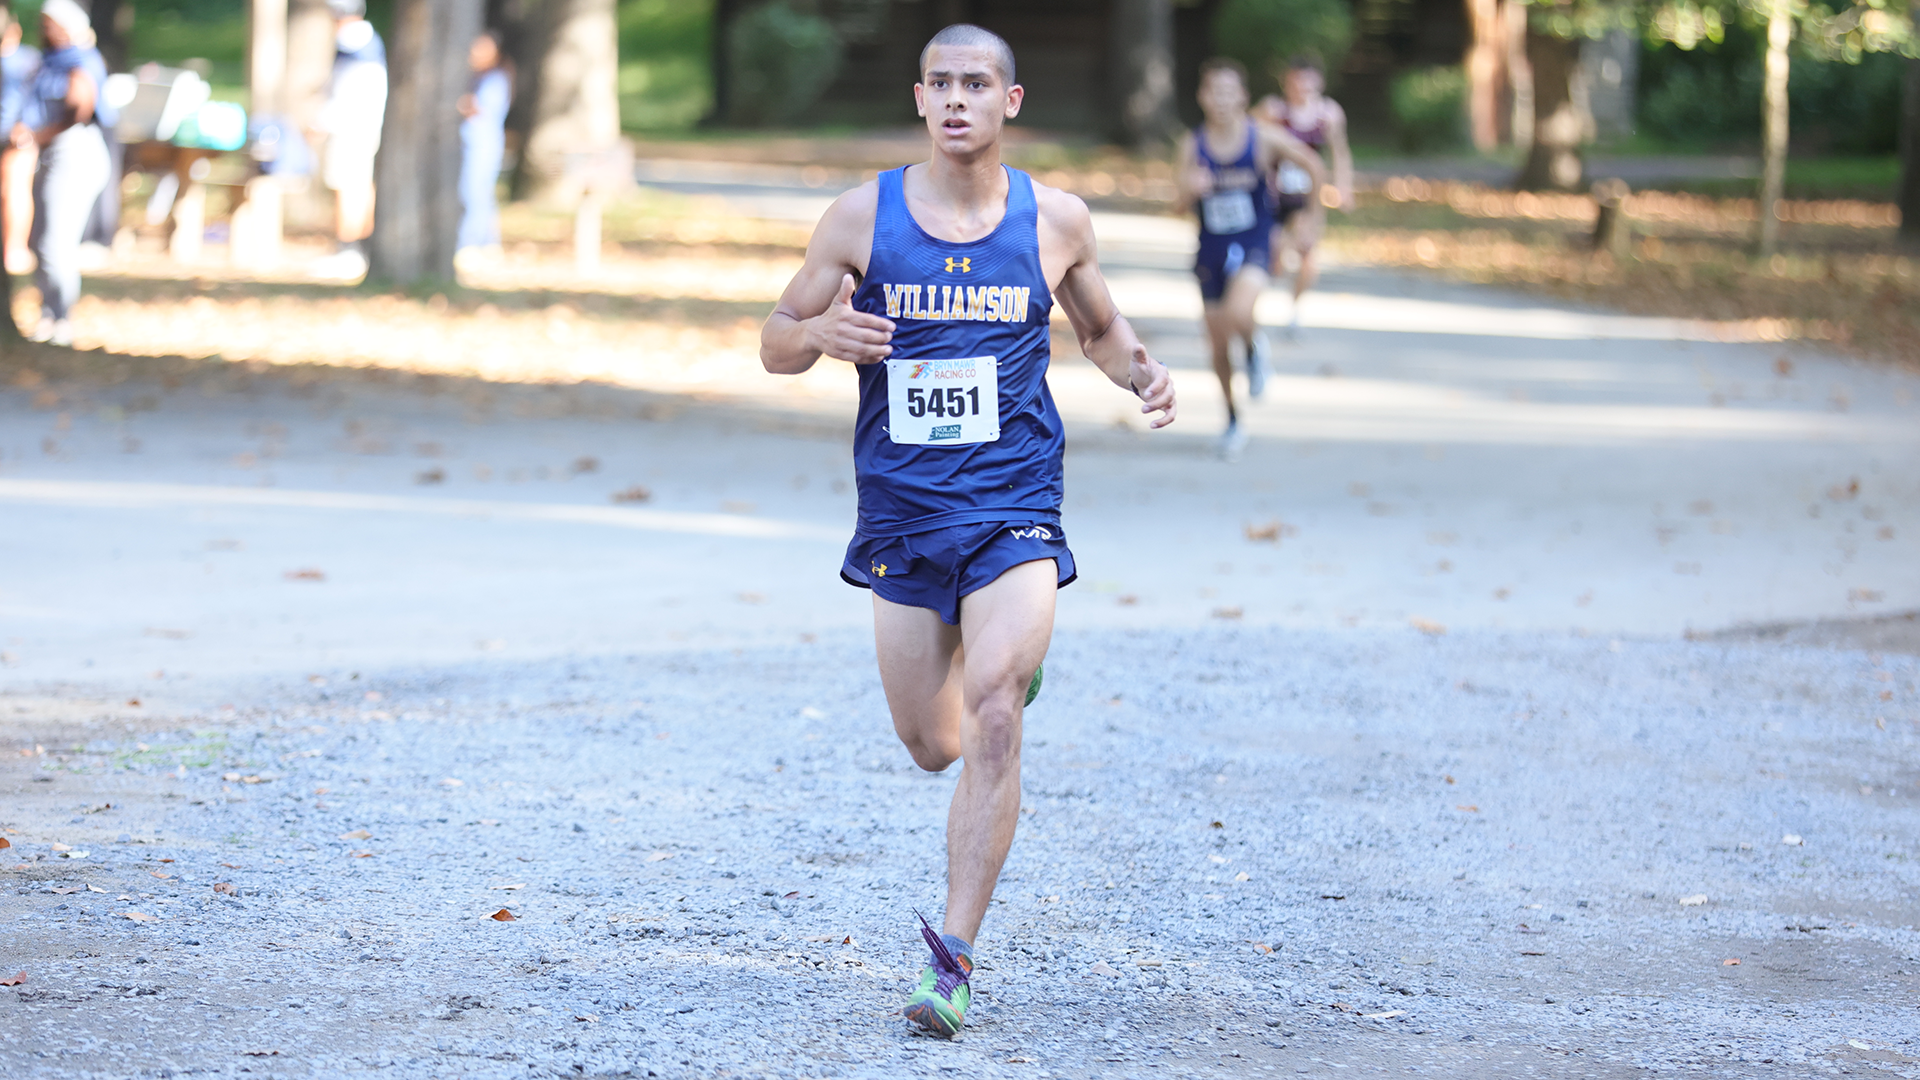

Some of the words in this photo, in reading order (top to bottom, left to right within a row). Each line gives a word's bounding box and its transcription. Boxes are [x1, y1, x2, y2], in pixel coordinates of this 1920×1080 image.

[883, 283, 1030, 323] WILLIAMSON
[934, 361, 952, 370] BRYN
[954, 359, 976, 369] MAWR
[935, 370, 963, 379] RACING
[965, 369, 976, 378] CO
[907, 386, 979, 418] 5451
